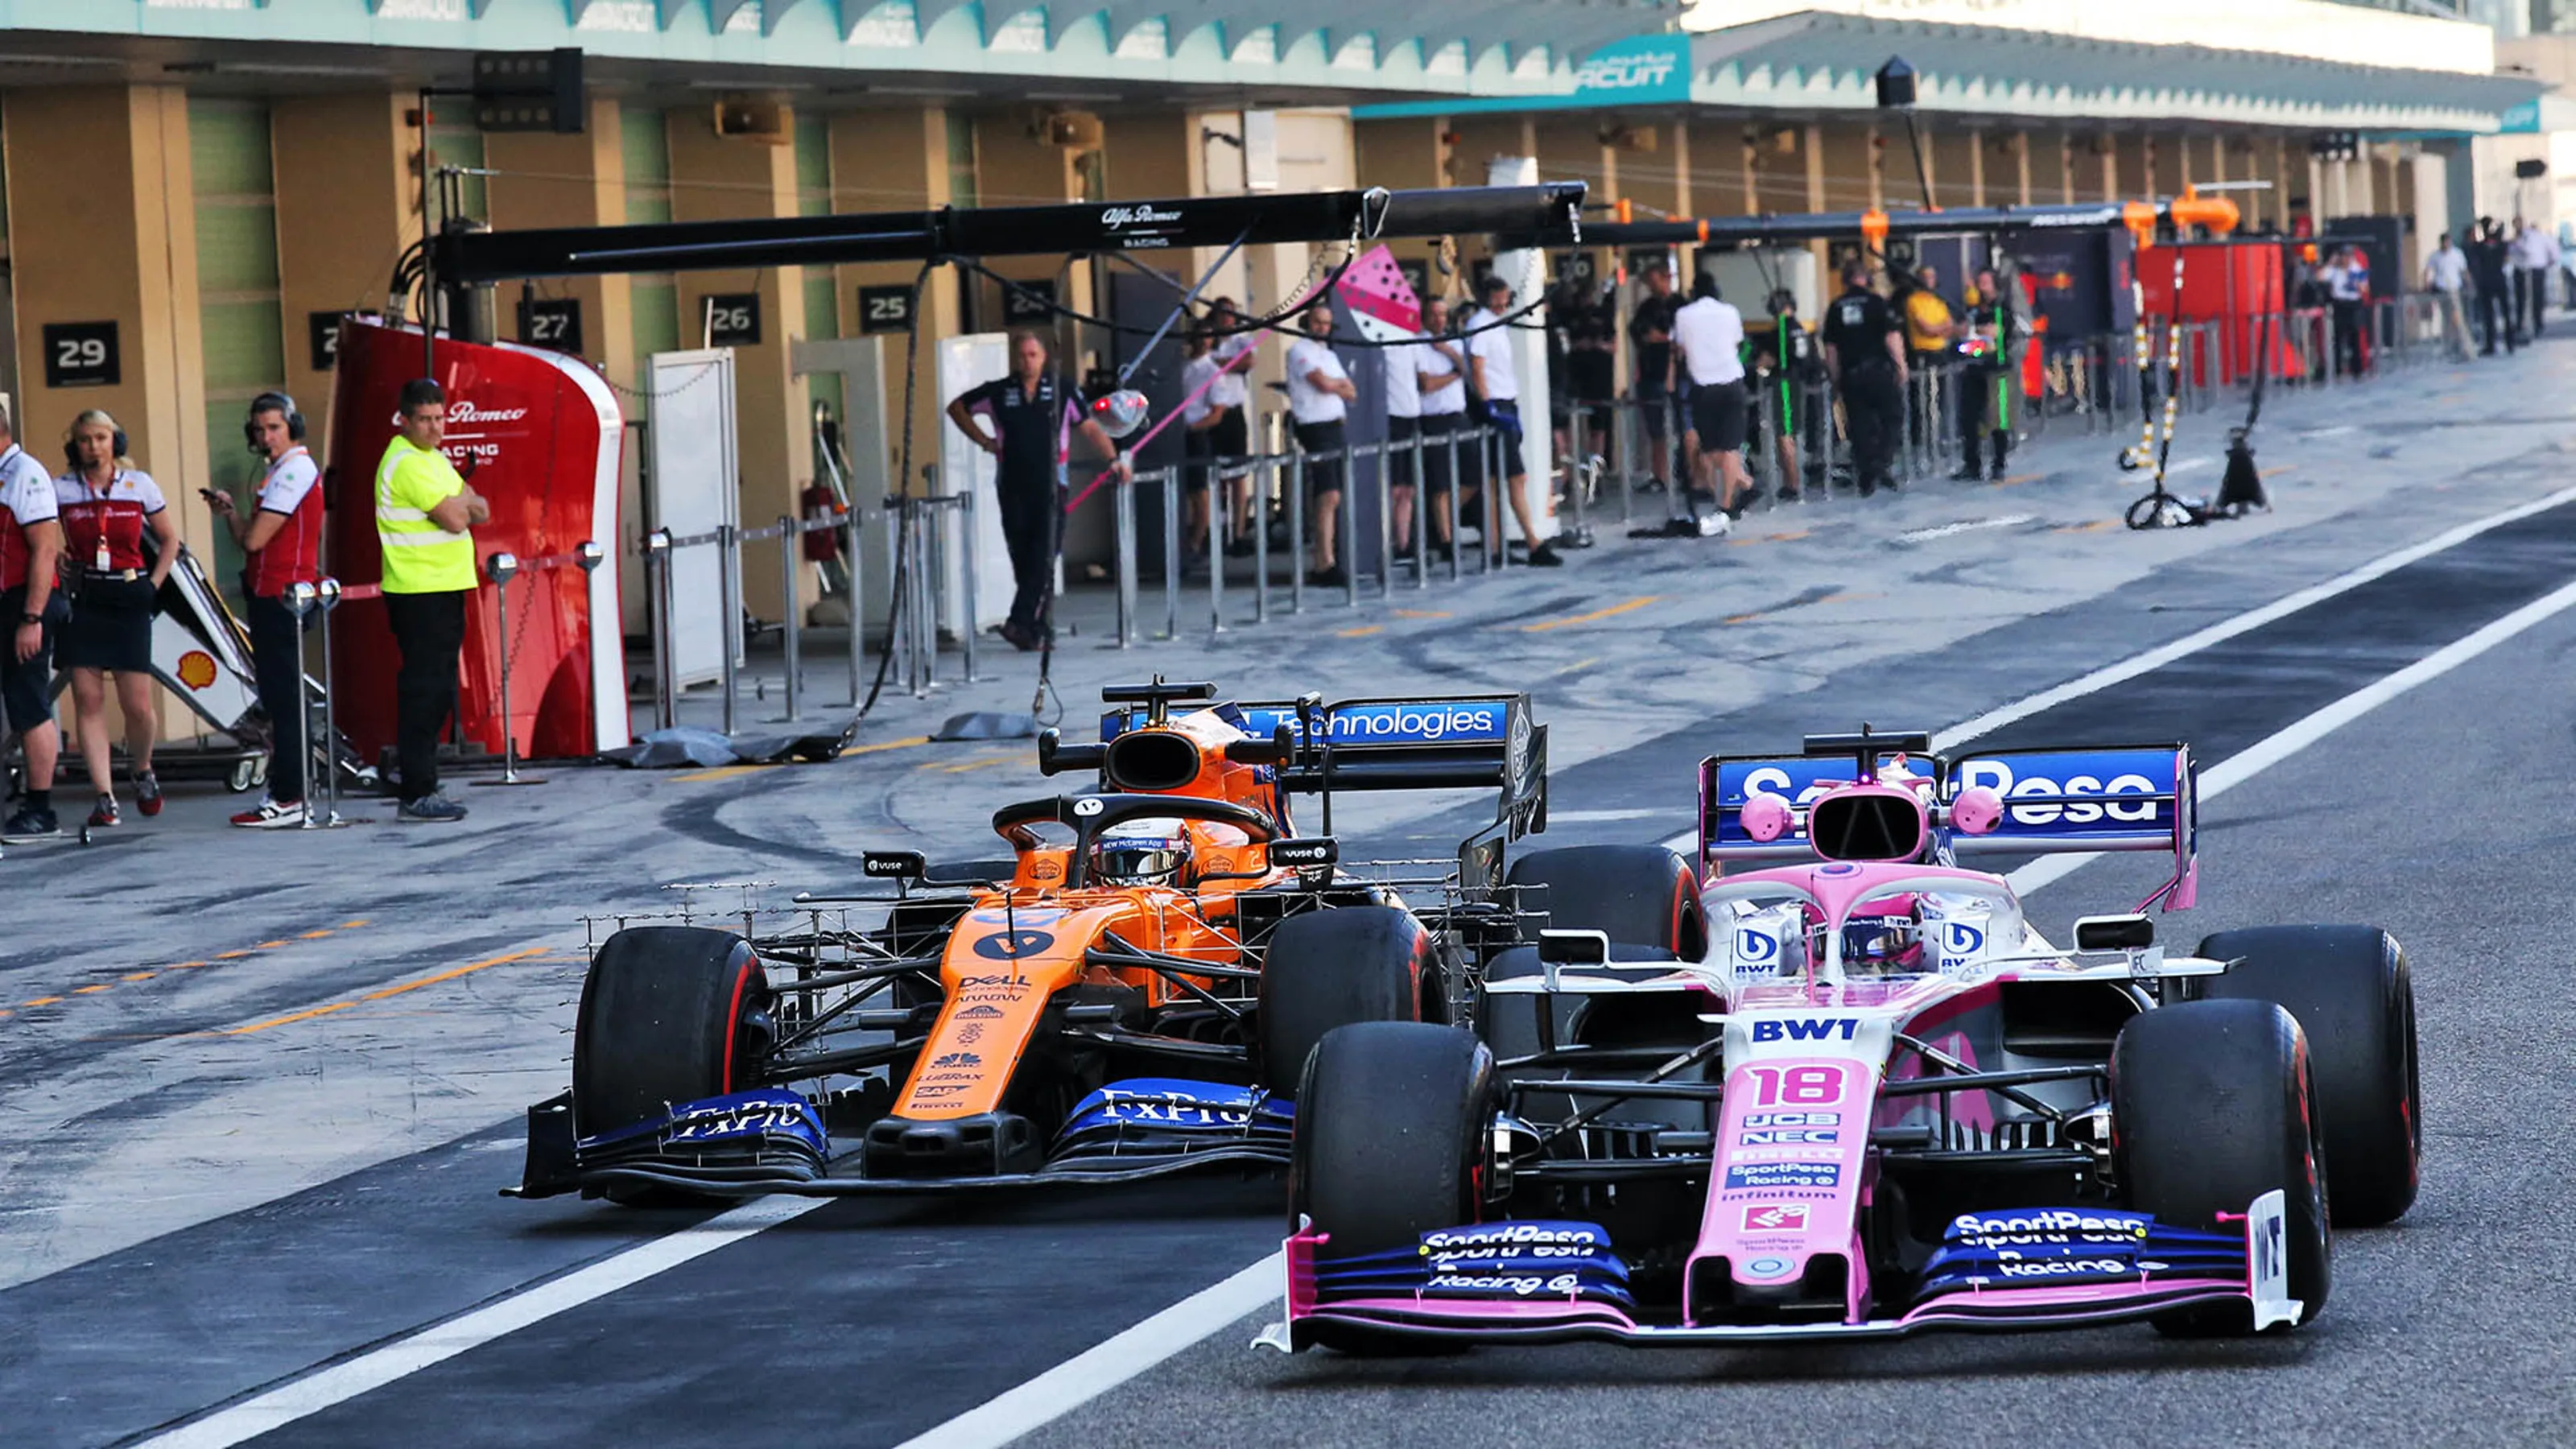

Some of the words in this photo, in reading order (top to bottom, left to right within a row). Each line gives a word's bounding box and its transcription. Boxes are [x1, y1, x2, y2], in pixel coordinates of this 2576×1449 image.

[712, 307, 750, 331] 26
[869, 297, 906, 320] 25
[531, 315, 568, 340] 27
[324, 328, 339, 353] 2
[57, 338, 106, 368] 29
[448, 401, 527, 423] Romeo
[878, 861, 902, 870] vuse
[1286, 849, 1313, 858] vuse
[959, 975, 1032, 988] DELL
[1752, 1018, 1859, 1042] BWT
[916, 1087, 958, 1096] SAP
[1747, 1066, 1845, 1108] 18
[1100, 1088, 1253, 1124] FxPro
[677, 1100, 803, 1137] FxPro
[1745, 1113, 1840, 1127] JCB
[1742, 1131, 1836, 1146] NEC
[1732, 1163, 1836, 1176] SportPesa
[1745, 1175, 1812, 1186] Racing
[1721, 1191, 1836, 1202] infinitum
[1955, 1212, 2145, 1250] SportPesa
[1426, 1225, 1595, 1263] SportPesa
[1999, 1250, 2126, 1277] Racing
[1428, 1264, 1543, 1295] Racing
